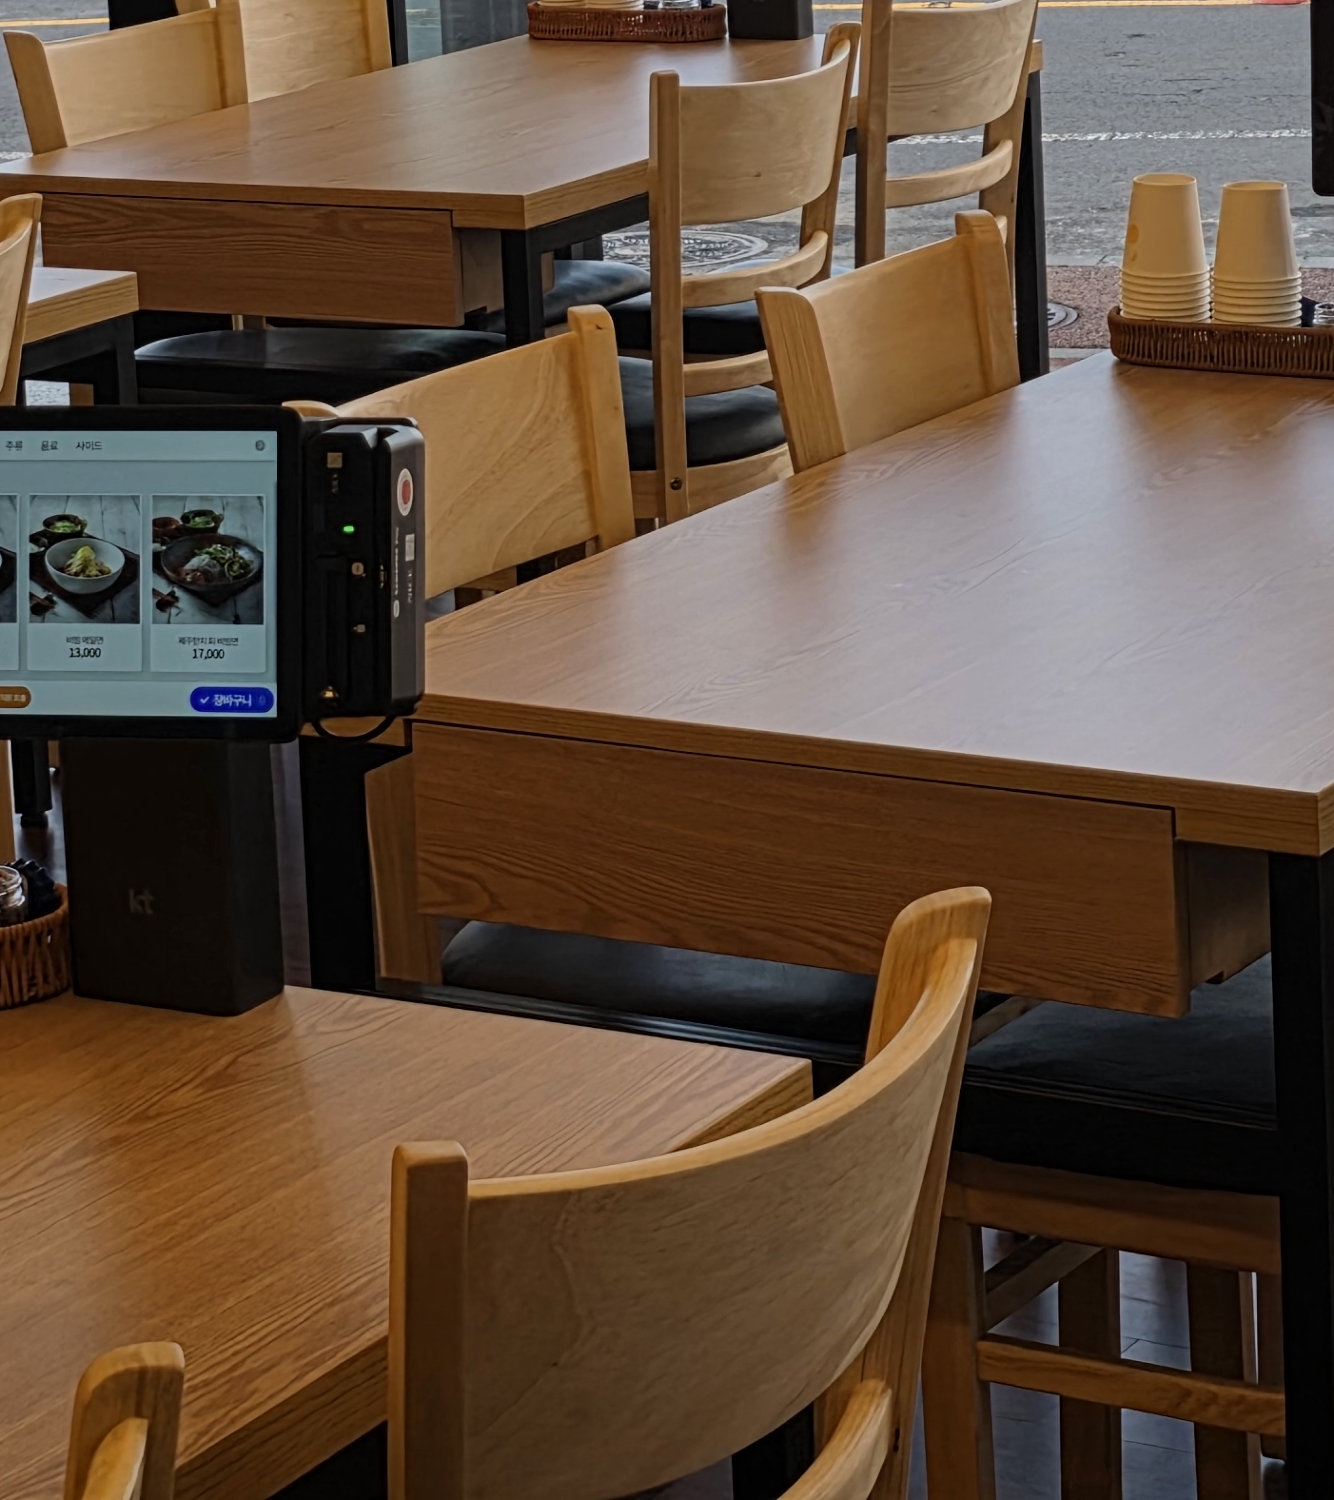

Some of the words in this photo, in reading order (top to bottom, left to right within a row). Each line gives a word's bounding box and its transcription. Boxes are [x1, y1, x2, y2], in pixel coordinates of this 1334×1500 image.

[75, 440, 103, 451] 사이드
[69, 647, 102, 659] 13,000
[192, 648, 225, 660] 17,000
[129, 888, 154, 915] kt
